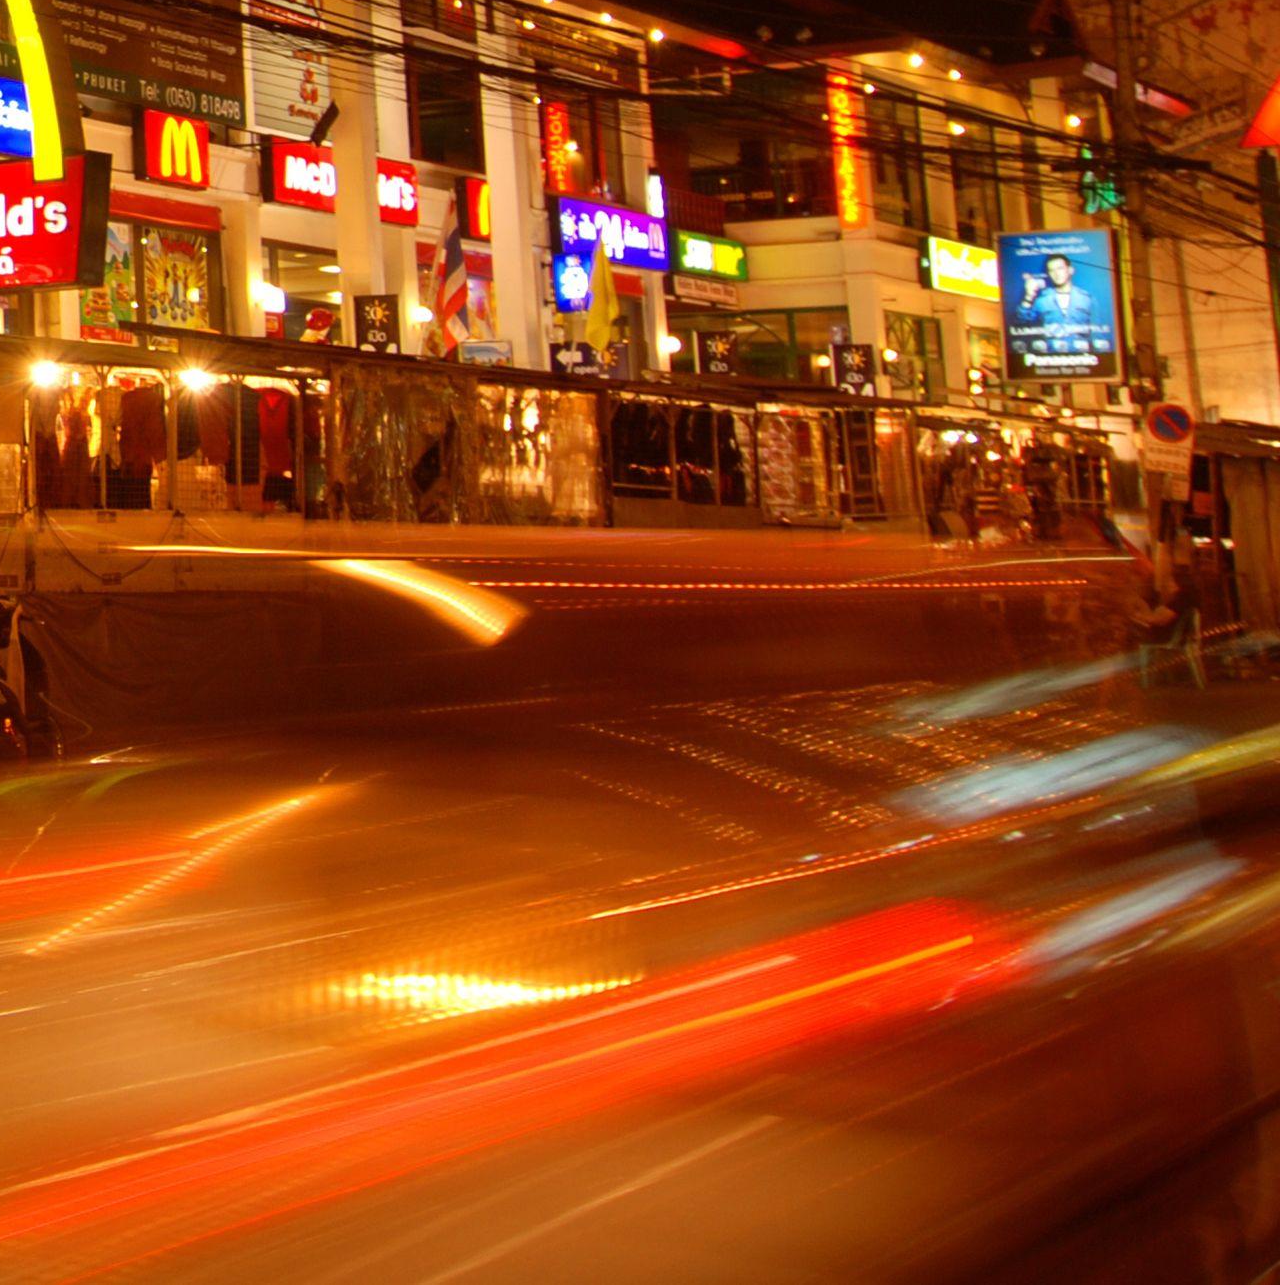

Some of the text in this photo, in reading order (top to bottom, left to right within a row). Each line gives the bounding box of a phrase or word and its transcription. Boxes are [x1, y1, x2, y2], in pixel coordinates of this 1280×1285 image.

[83, 71, 241, 120] PHUKET Tel: (053) 818498
[1023, 352, 1100, 368] Panasonic
